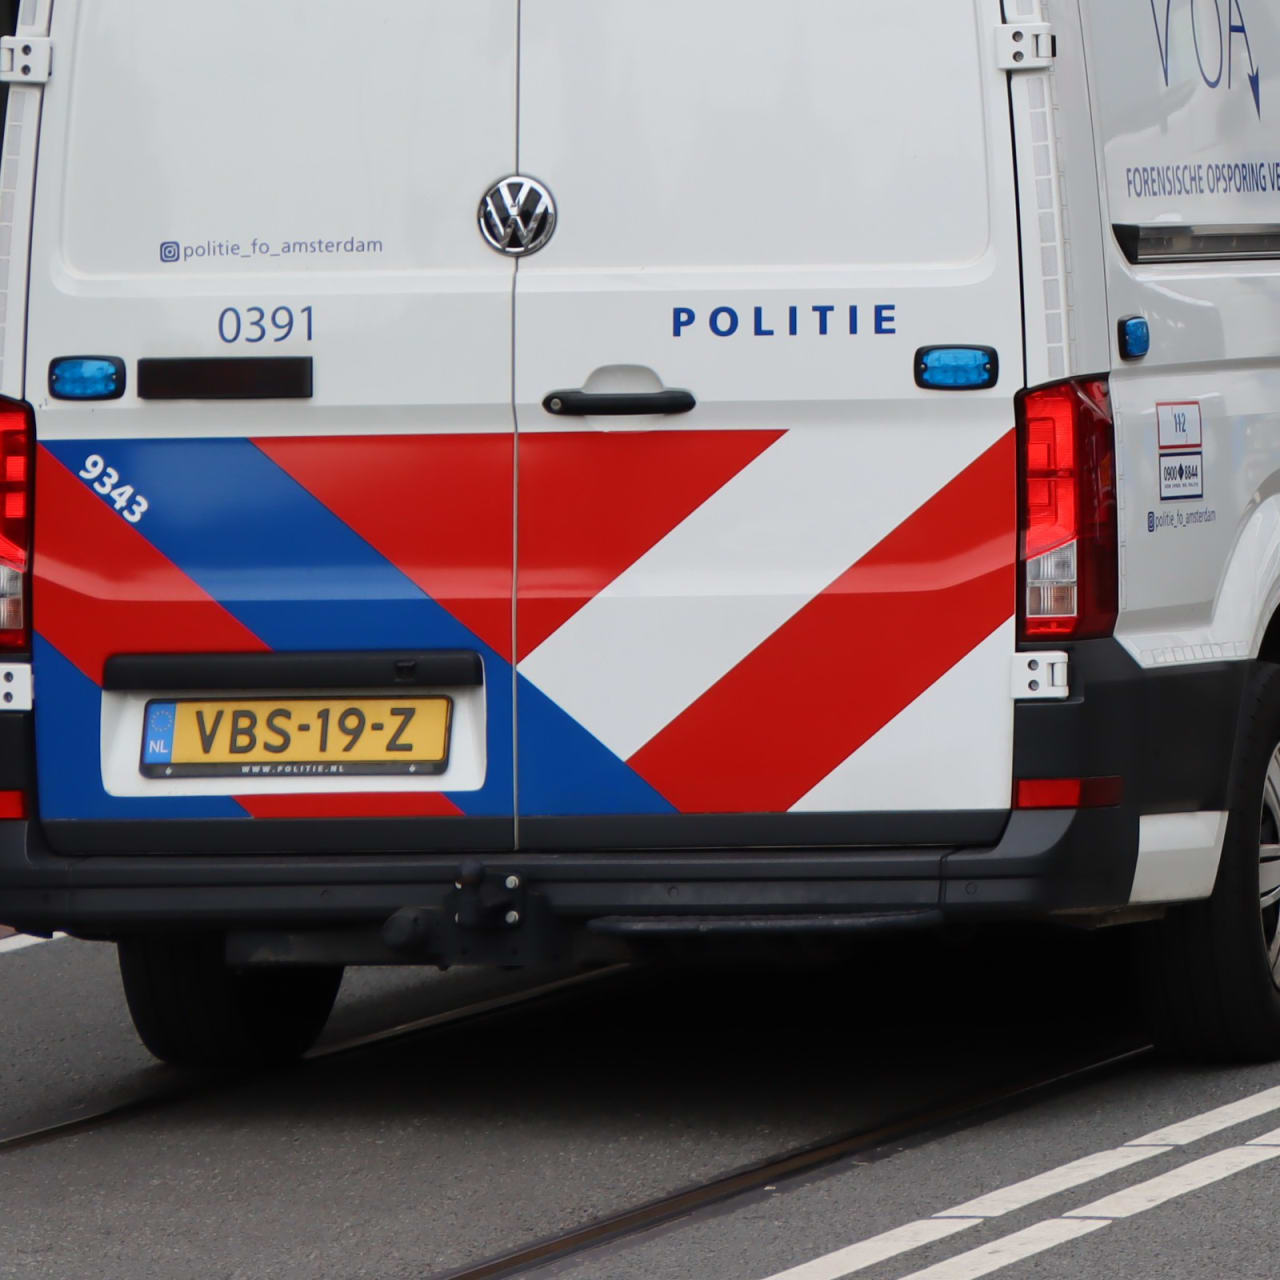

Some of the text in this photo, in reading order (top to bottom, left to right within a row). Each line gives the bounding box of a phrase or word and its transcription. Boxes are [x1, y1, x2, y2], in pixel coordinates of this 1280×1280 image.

[1126, 165, 1204, 198] FORENSISCHE
[1206, 162, 1267, 194] OPSPORING
[184, 236, 383, 261] politie_fo_amsterdam
[218, 306, 313, 343] 0391
[672, 304, 896, 337] POLITIE
[79, 454, 149, 523] 9343
[1164, 464, 1199, 481] 0900 8844
[149, 707, 416, 754] NL VBS-19-Z
[241, 764, 345, 774] WWW.POLITIE.NL
